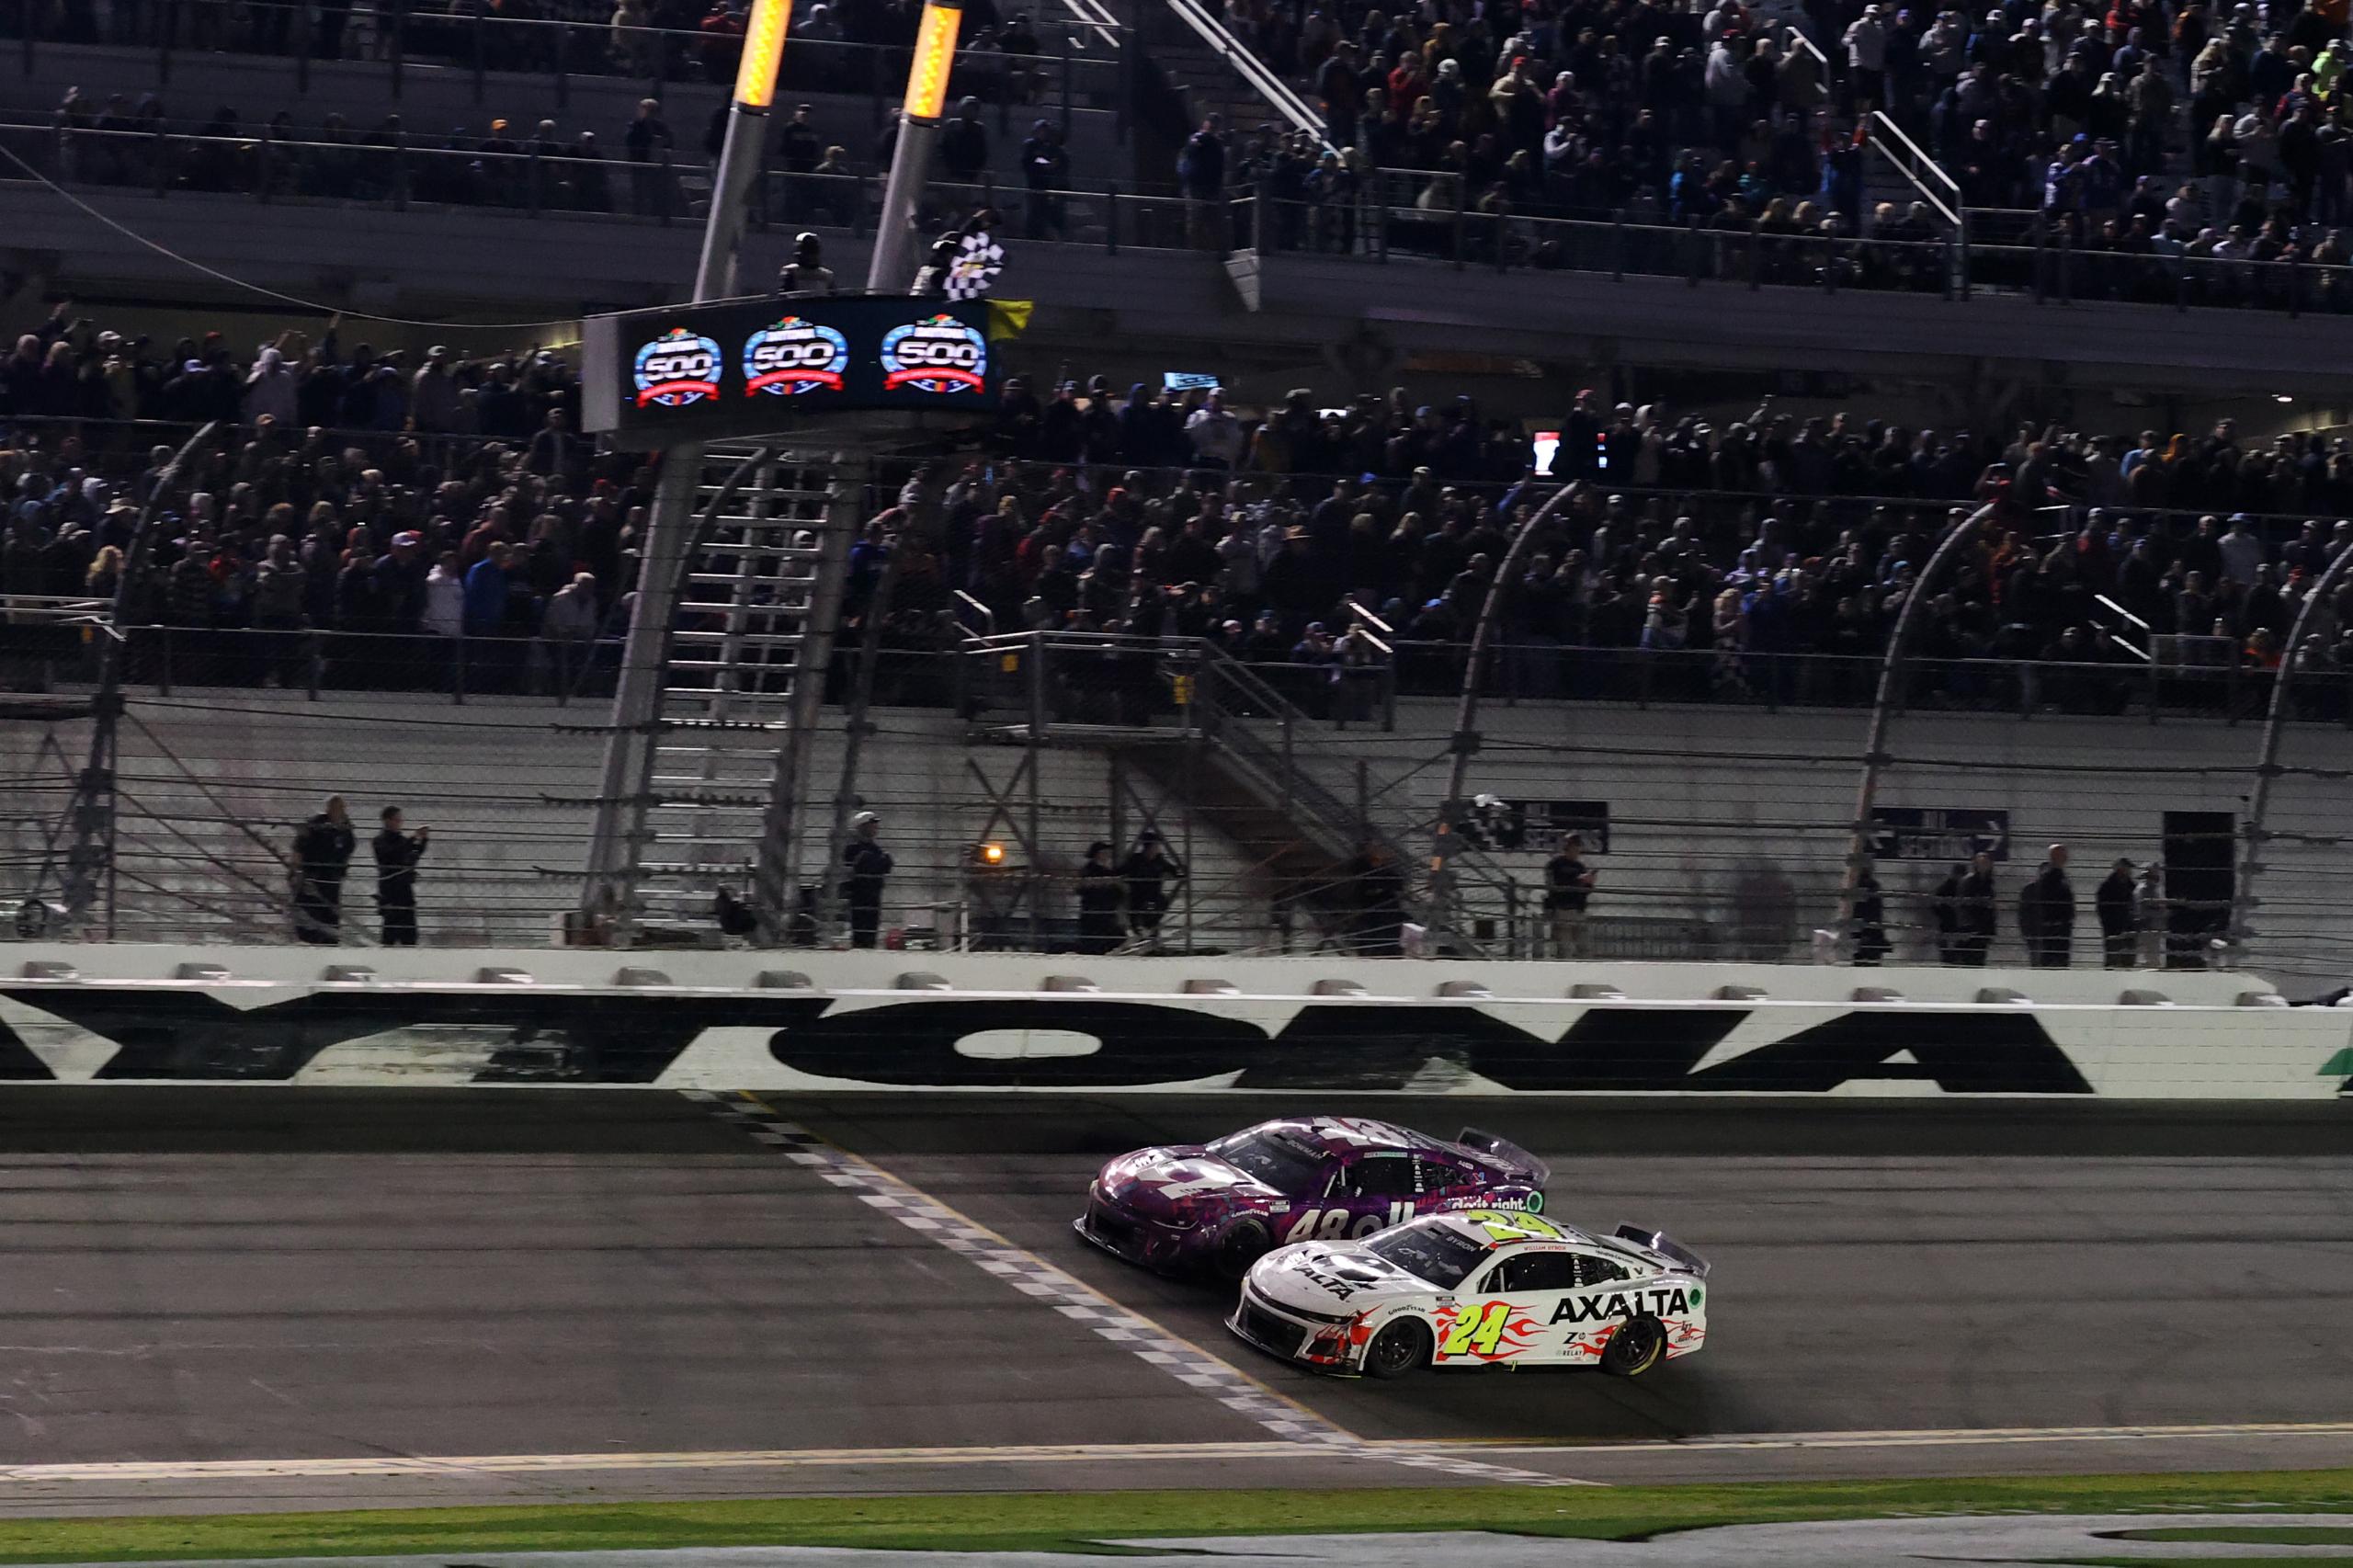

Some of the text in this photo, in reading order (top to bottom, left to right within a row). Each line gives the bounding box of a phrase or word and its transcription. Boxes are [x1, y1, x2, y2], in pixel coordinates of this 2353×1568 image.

[645, 353, 713, 381] 500
[754, 342, 835, 370] 500
[897, 341, 978, 367] 500
[1231, 1207, 1269, 1219] GOODYEAR
[1491, 1197, 1527, 1212] right.
[1285, 1208, 1350, 1241] 48
[1465, 1209, 1568, 1242] 24
[1445, 1234, 1477, 1253] BYRON
[1387, 1304, 1427, 1316] GOODYEAR
[1548, 1288, 1689, 1325] AXALTA
[1442, 1304, 1512, 1356] 24
